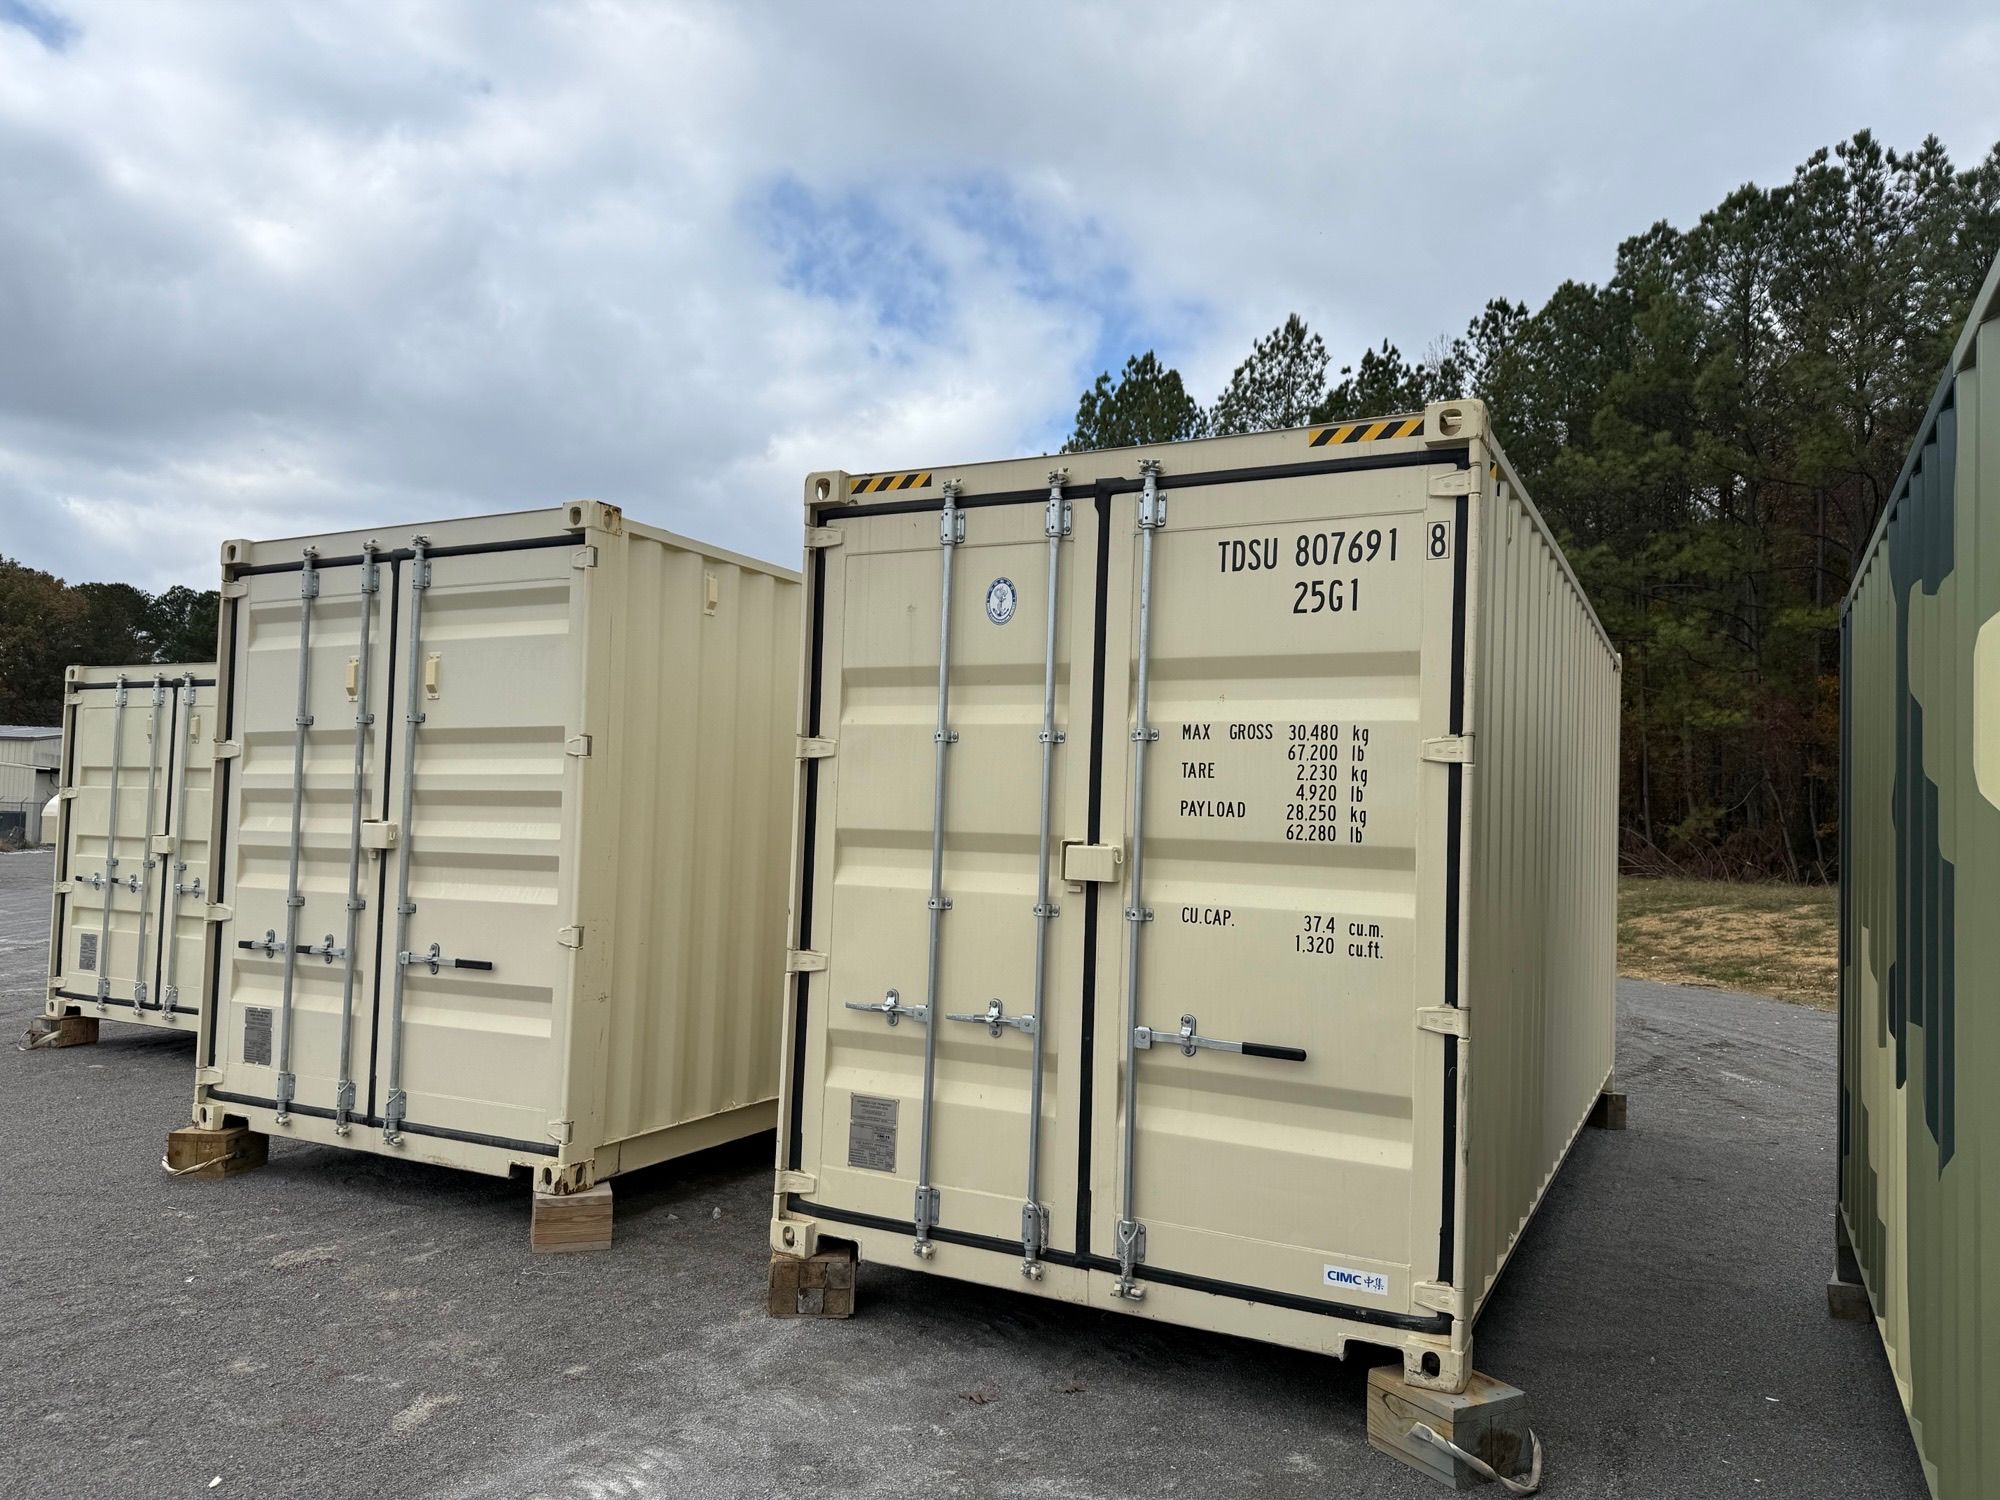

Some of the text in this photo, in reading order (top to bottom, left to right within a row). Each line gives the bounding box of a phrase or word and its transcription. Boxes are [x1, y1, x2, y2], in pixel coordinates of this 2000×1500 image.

[1217, 523, 1446, 573] TDSU 807691 8
[1292, 577, 1359, 615] 25G1
[1182, 723, 1369, 747] MAX GROSS 30.480 kg
[1287, 743, 1365, 762] 67.200 lb
[1181, 761, 1368, 788] TARE 2.230 kg
[1295, 783, 1364, 803] 4.920 lb
[1180, 799, 1367, 829] PAYLOAD 28.250 kg
[1285, 823, 1363, 844] 62.280 lb
[1181, 906, 1384, 939] CU.CAP. 37.4 cu.m.
[1295, 934, 1384, 960] 1.320 cu.ft.
[1327, 1270, 1362, 1286] CIMC
